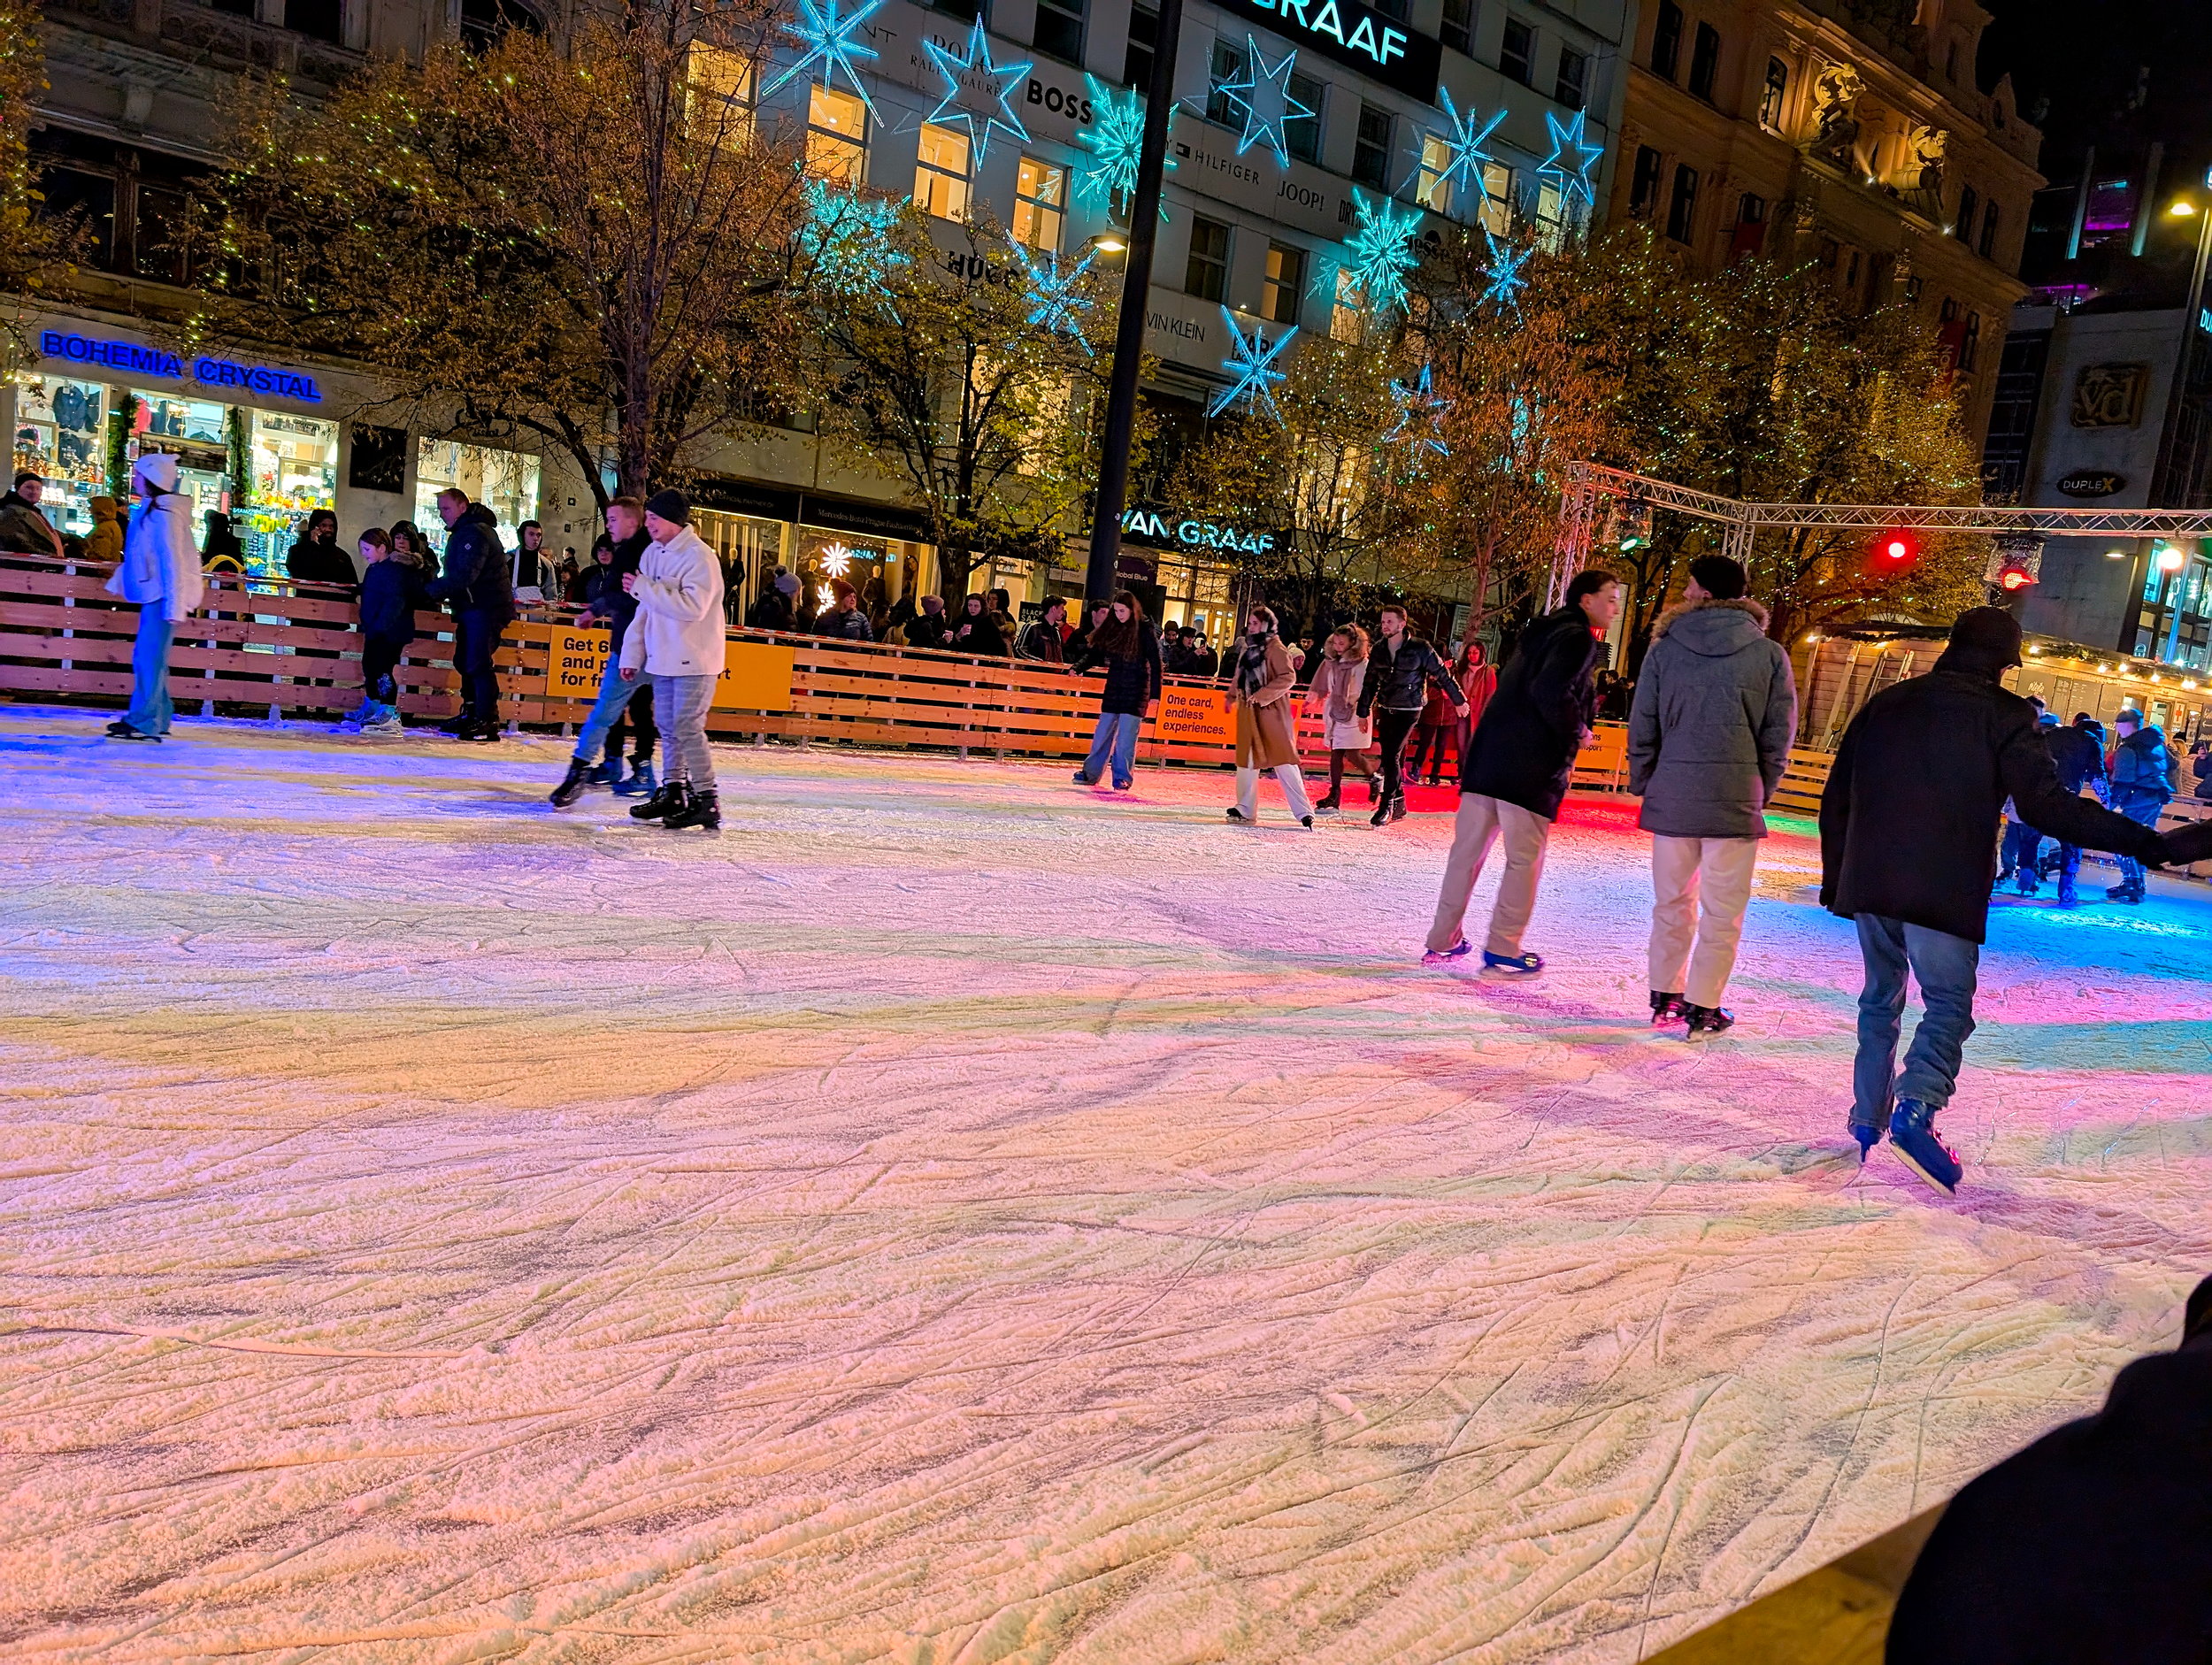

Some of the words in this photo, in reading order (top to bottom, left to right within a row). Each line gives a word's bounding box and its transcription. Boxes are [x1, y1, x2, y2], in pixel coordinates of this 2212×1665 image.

[1026, 78, 1094, 125] BOSS
[1194, 150, 1260, 186] HILFIGER
[1277, 180, 1325, 211] JOOP!
[1171, 318, 1205, 342] KLEIN
[42, 331, 183, 379] BOHEMIA
[196, 359, 321, 401] CRYSTAL
[2062, 477, 2116, 493] DUPLEX
[1178, 519, 1275, 555] GRAAF
[1134, 572, 1148, 581] Blue
[564, 637, 594, 652] Get
[599, 640, 611, 653] 6
[562, 656, 595, 670] and
[560, 671, 586, 687] for
[1167, 694, 1187, 706] One
[1188, 697, 1214, 710] card,
[1164, 708, 1204, 720] endless
[1163, 721, 1226, 735] experiences.
